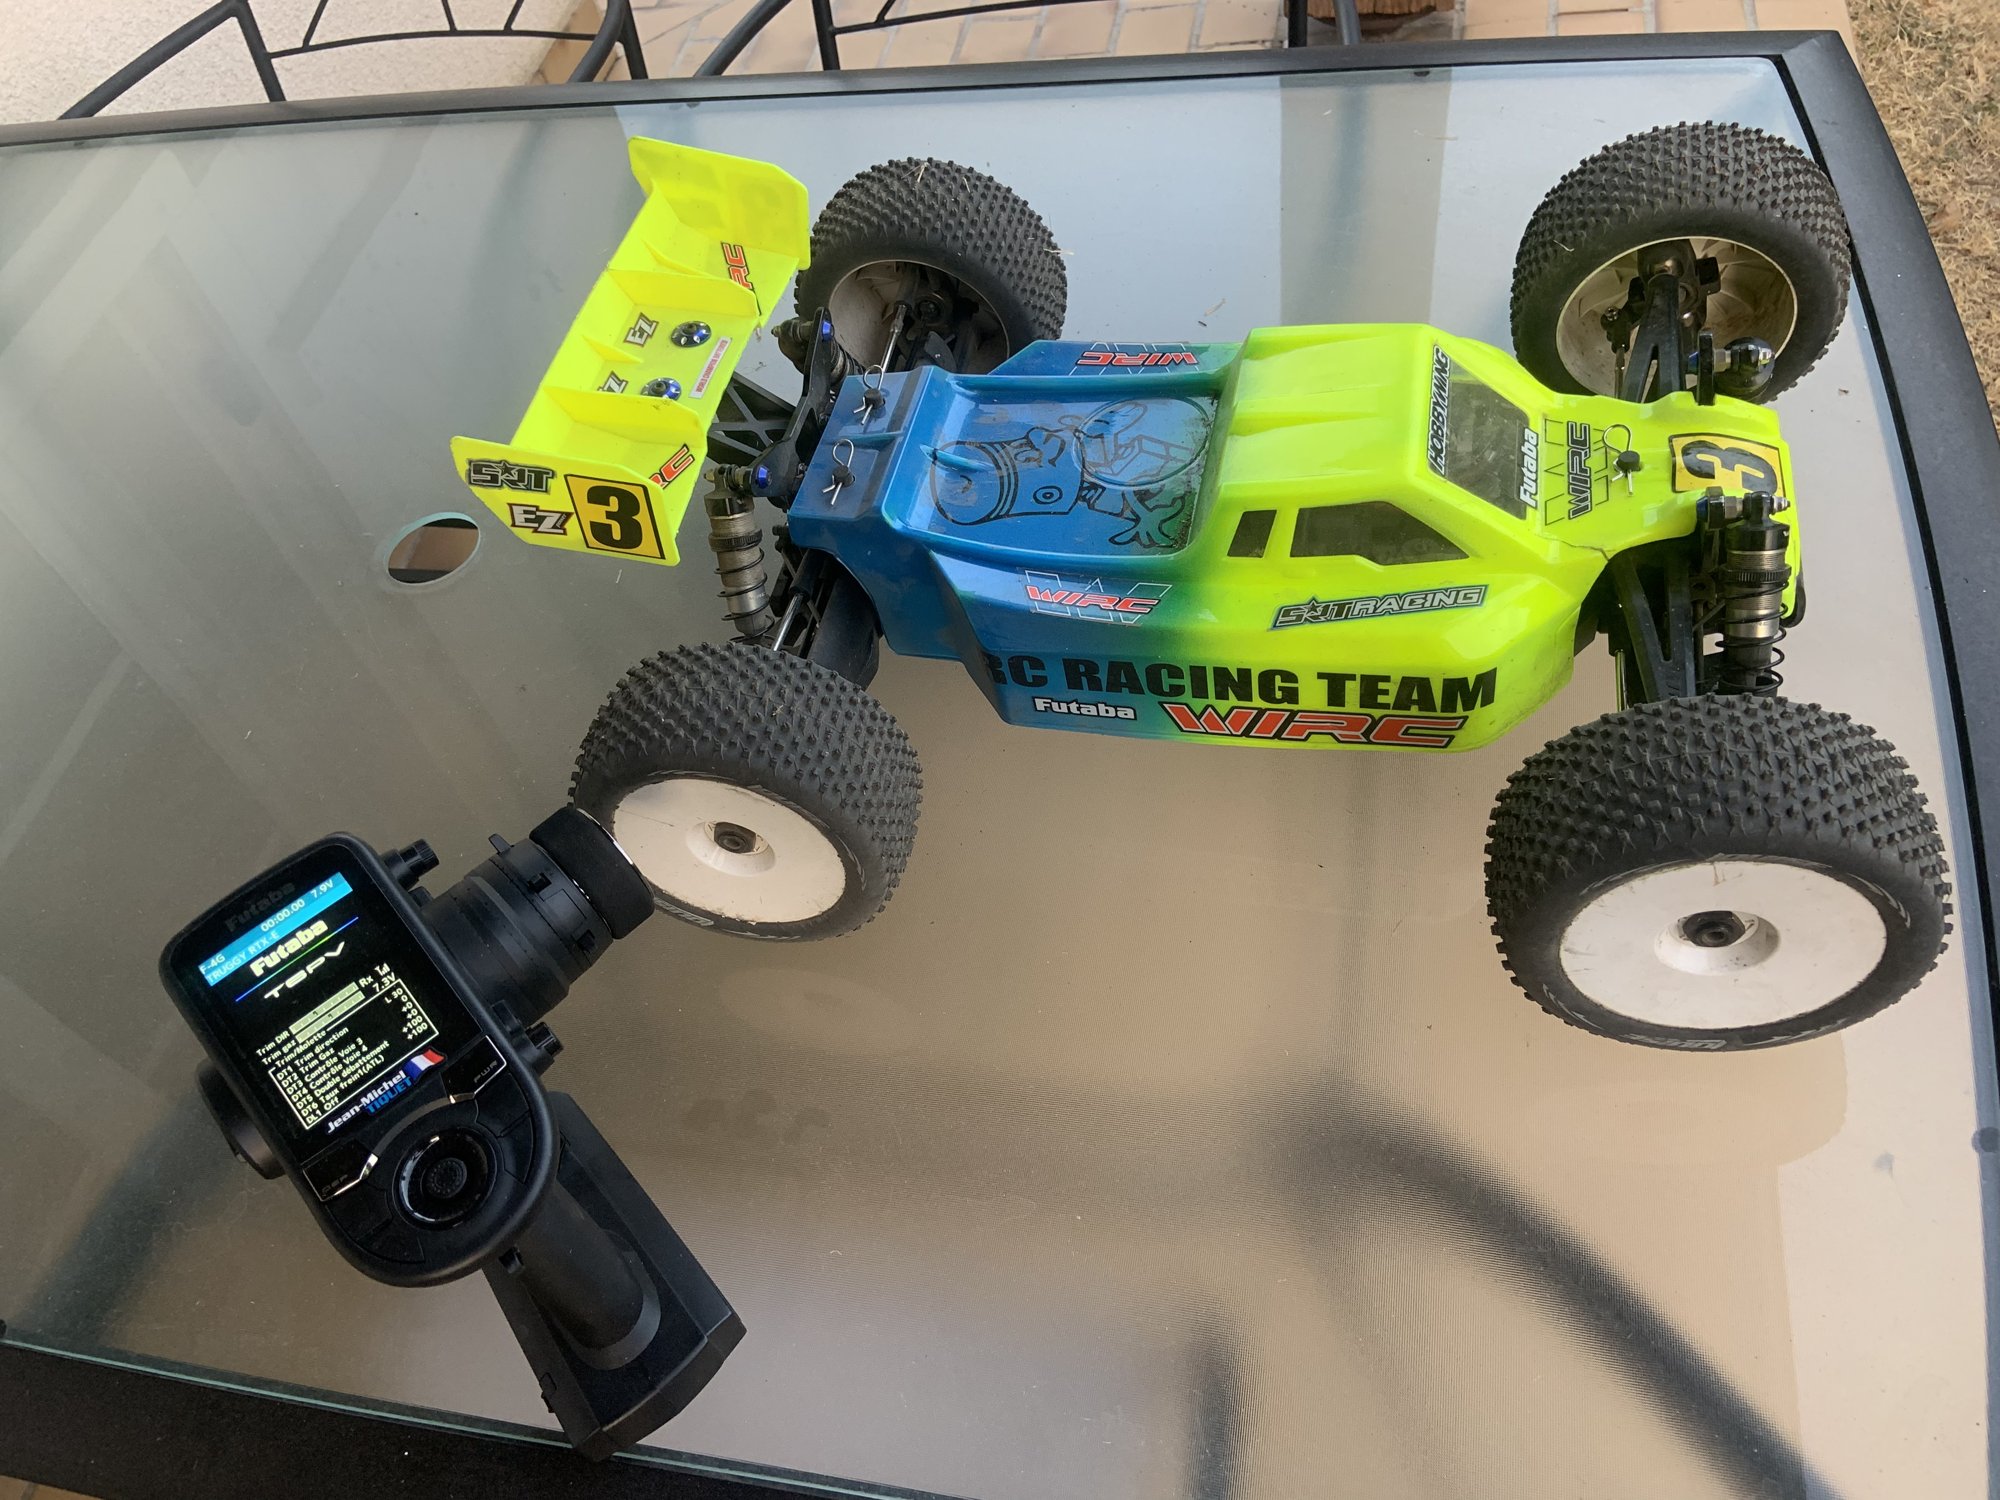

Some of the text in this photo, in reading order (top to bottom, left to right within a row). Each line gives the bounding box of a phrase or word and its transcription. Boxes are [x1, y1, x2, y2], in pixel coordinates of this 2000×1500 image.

[625, 313, 659, 347] EZ
[597, 371, 629, 394] Z
[1075, 350, 1199, 366] WIRC
[1427, 345, 1450, 477] HOBBYWING
[1519, 427, 1539, 509] Futaba
[1567, 421, 1593, 520] WIRC
[1681, 440, 1778, 495] 3
[508, 503, 573, 535] EZ
[587, 485, 643, 549] 3
[1025, 585, 1161, 614] WIRC
[1032, 696, 1137, 721] Futaba
[1062, 658, 1300, 705] RACING
[1317, 667, 1497, 713] TEAM
[1158, 702, 1469, 749] WIRC
[199, 879, 334, 975] F-4G 00:00.00 7.9V
[249, 919, 329, 977] Futaba
[205, 950, 250, 985] TRUGGY
[373, 972, 398, 993] 7.3V
[255, 975, 374, 1057] Trim DIR Rx
[276, 1065, 294, 1081] DT1
[293, 1051, 315, 1067] Trim
[314, 1027, 349, 1054] direction
[391, 987, 404, 999] 30
[261, 1039, 297, 1065] Trim gaz
[273, 1030, 327, 1068] Trim/Molette
[281, 1072, 299, 1088] DT2
[298, 1059, 320, 1074] Trim
[318, 1047, 335, 1061] Gaz
[286, 1001, 413, 1095] DT3 Contrôle Voie 3 +0
[291, 1008, 418, 1103] DT4 Contrôle Voie 4 +0
[295, 1015, 423, 1110] DT5 Double débattement +100
[300, 1101, 319, 1117] DT6
[318, 1087, 340, 1104] Taux
[407, 1022, 428, 1040] +100
[305, 1096, 342, 1125] DL1 Off
[327, 1070, 408, 1133] Jean-Michel
[364, 1077, 414, 1115] TIQUET
